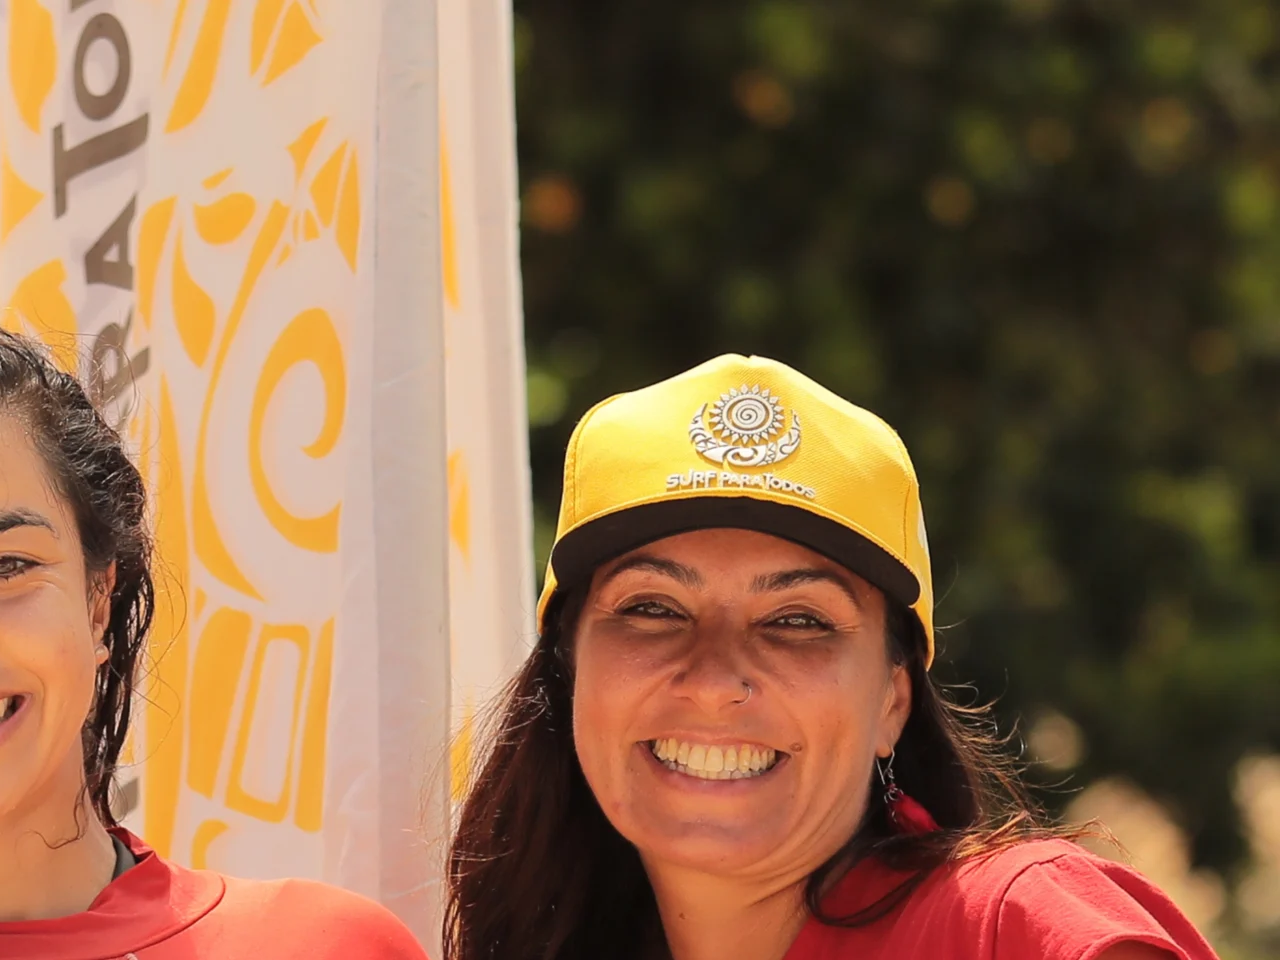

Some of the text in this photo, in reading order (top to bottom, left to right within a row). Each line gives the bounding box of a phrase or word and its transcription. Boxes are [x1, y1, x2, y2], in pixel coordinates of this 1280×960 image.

[53, 0, 150, 220] TO
[666, 468, 816, 499] SURF PARA TODOS
